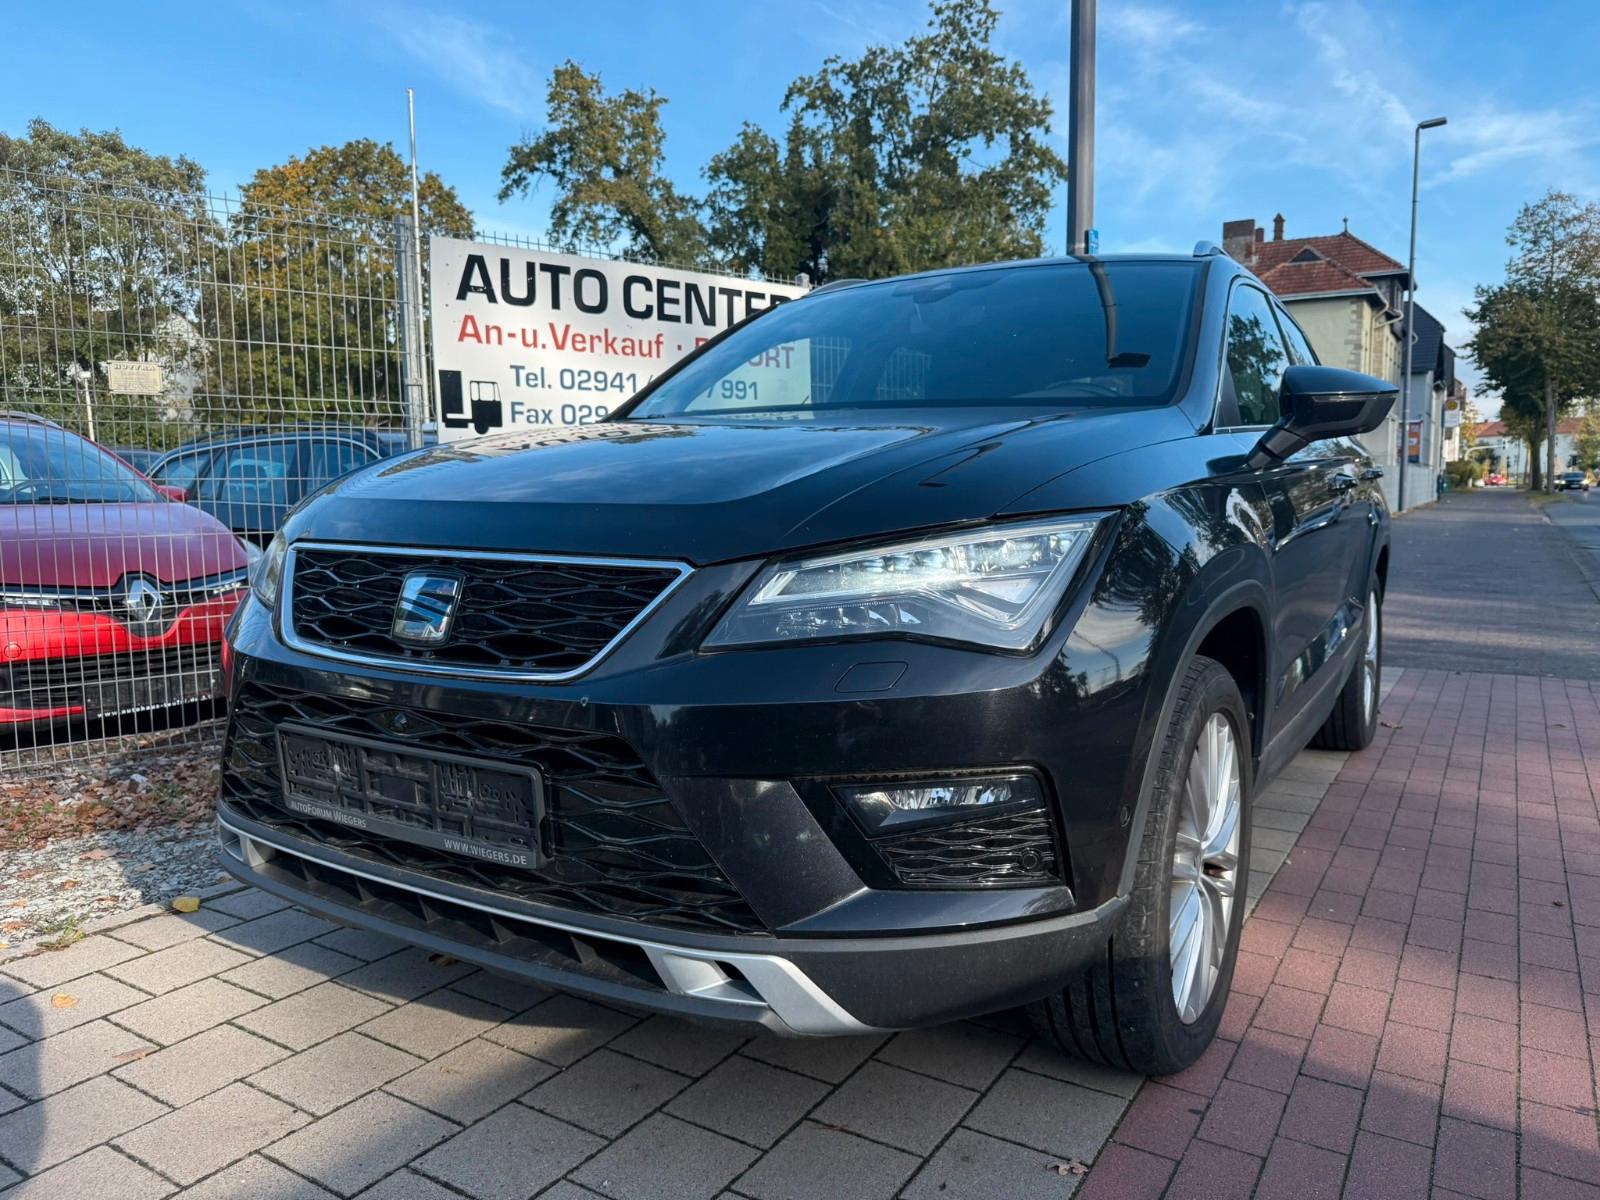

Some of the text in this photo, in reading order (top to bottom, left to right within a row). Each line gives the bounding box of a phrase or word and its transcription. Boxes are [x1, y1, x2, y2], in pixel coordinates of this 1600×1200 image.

[456, 254, 608, 314] AUTO
[510, 364, 552, 389] Tel.
[560, 368, 637, 393] 02941
[510, 401, 553, 424] Fax
[444, 839, 527, 865] WWW.WIEGERS.DE
